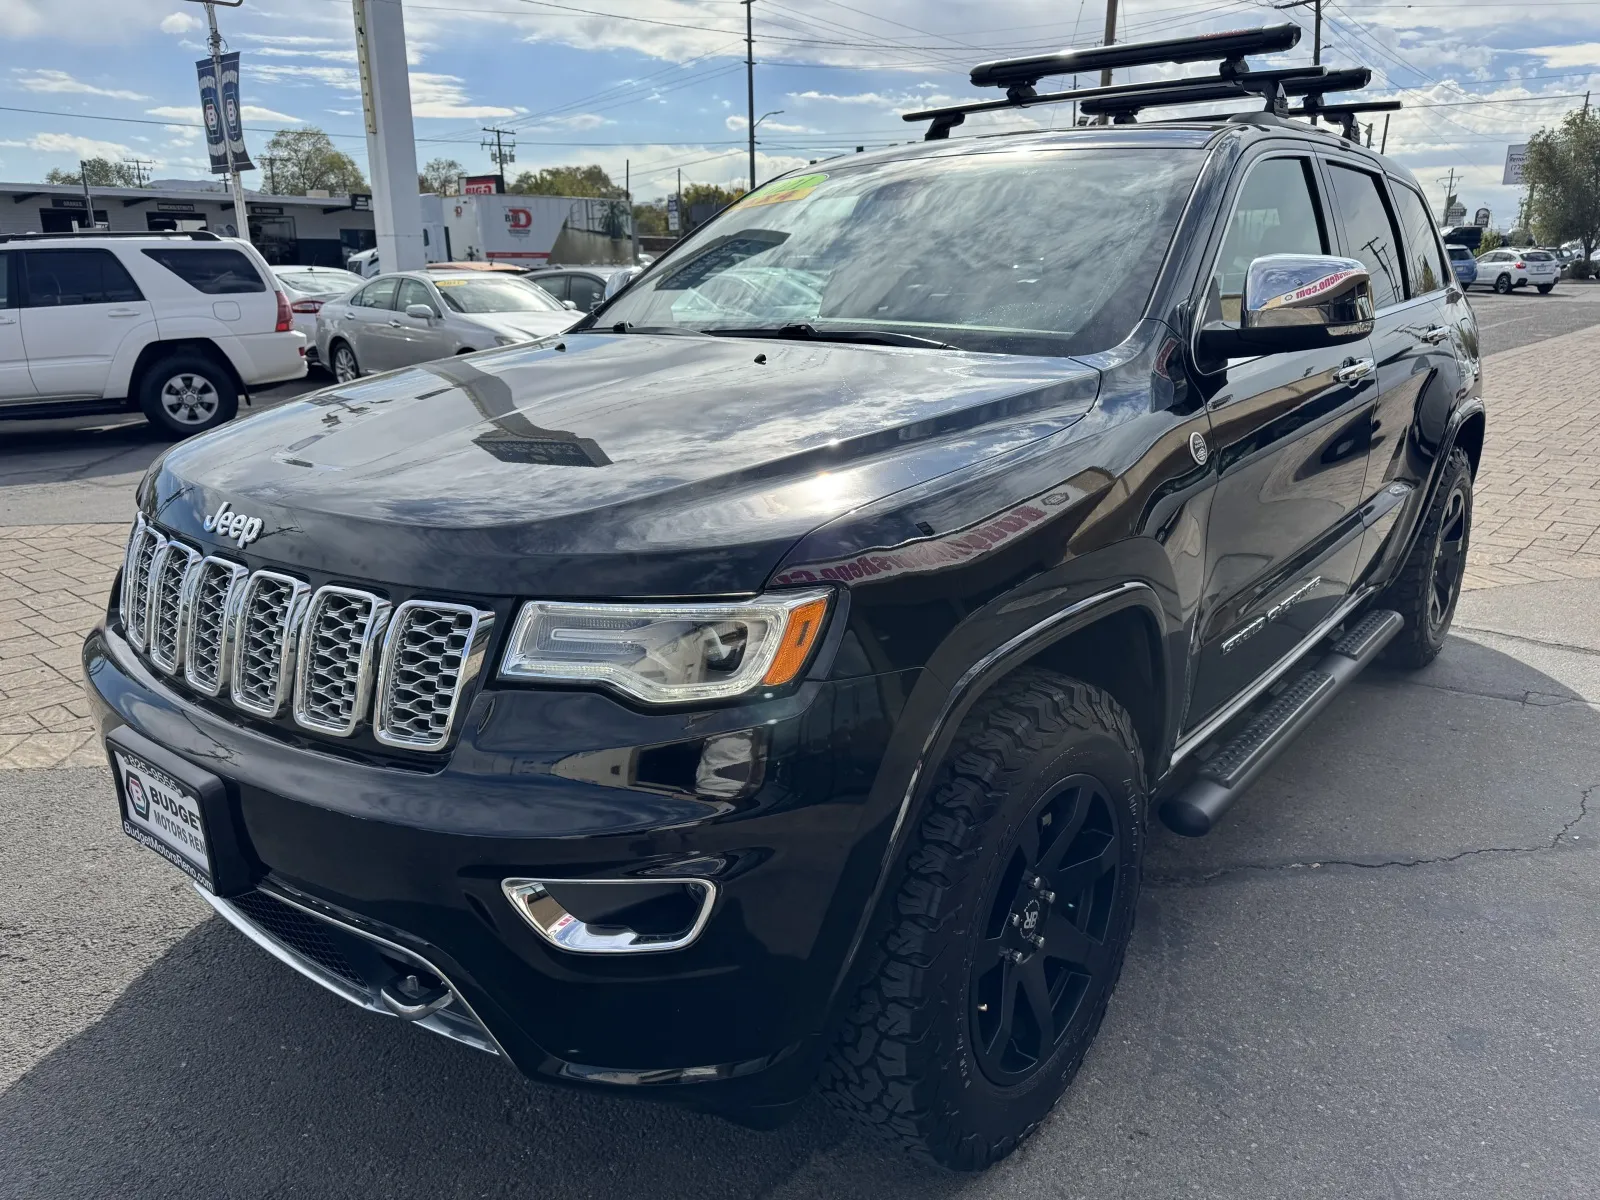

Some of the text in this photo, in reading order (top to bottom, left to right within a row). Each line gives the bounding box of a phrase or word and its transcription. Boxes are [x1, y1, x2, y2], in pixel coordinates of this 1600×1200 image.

[203, 501, 264, 549] Jeep
[153, 809, 188, 845] MOTORS
[123, 820, 214, 893] BudgetMotorsReno.com
